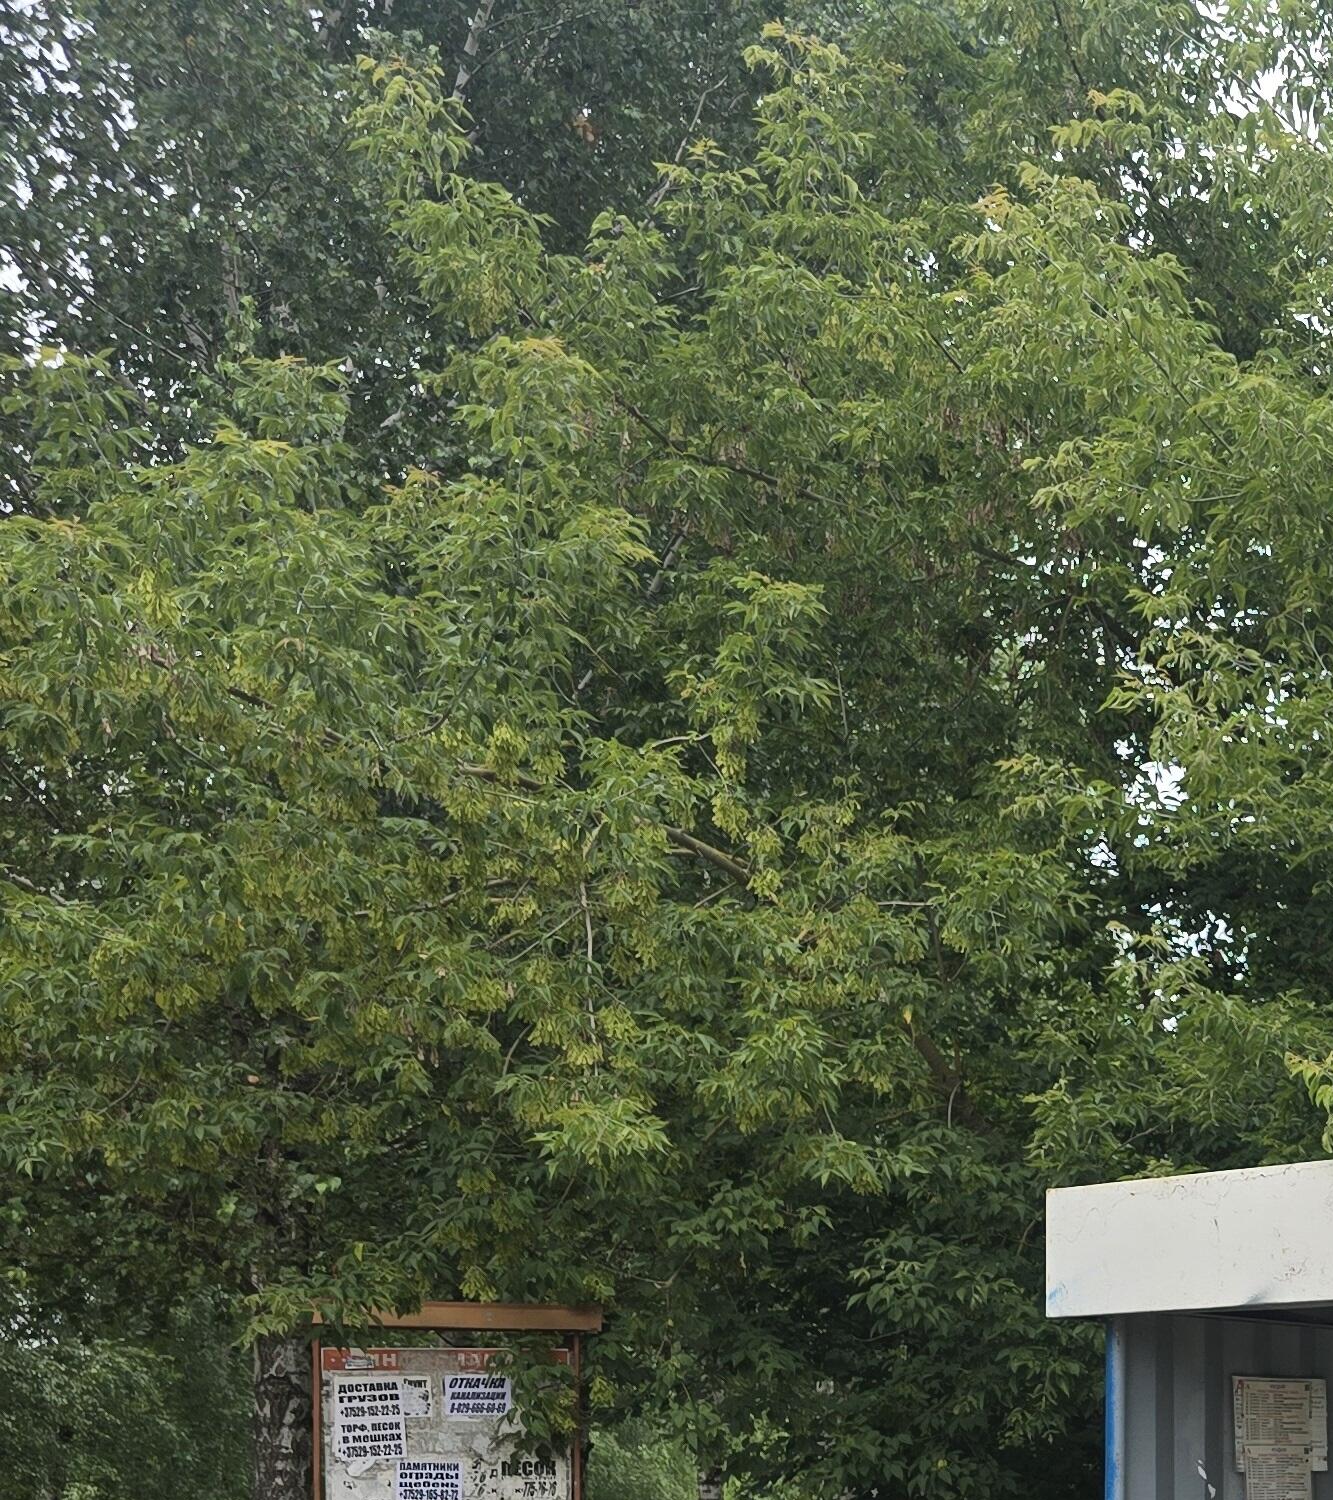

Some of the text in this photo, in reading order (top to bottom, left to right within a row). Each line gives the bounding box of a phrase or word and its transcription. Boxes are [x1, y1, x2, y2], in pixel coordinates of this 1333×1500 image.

[449, 1377, 506, 1388] ОТКАЧКА
[338, 1382, 398, 1394] ДОСТАВКА
[338, 1393, 400, 1403] ГРУЗОВ
[450, 1392, 506, 1401] КАНАЛИЗАЦИИ
[371, 1421, 401, 1431] ПЕСОК
[399, 1462, 459, 1471] ПАМЯТНИКИ
